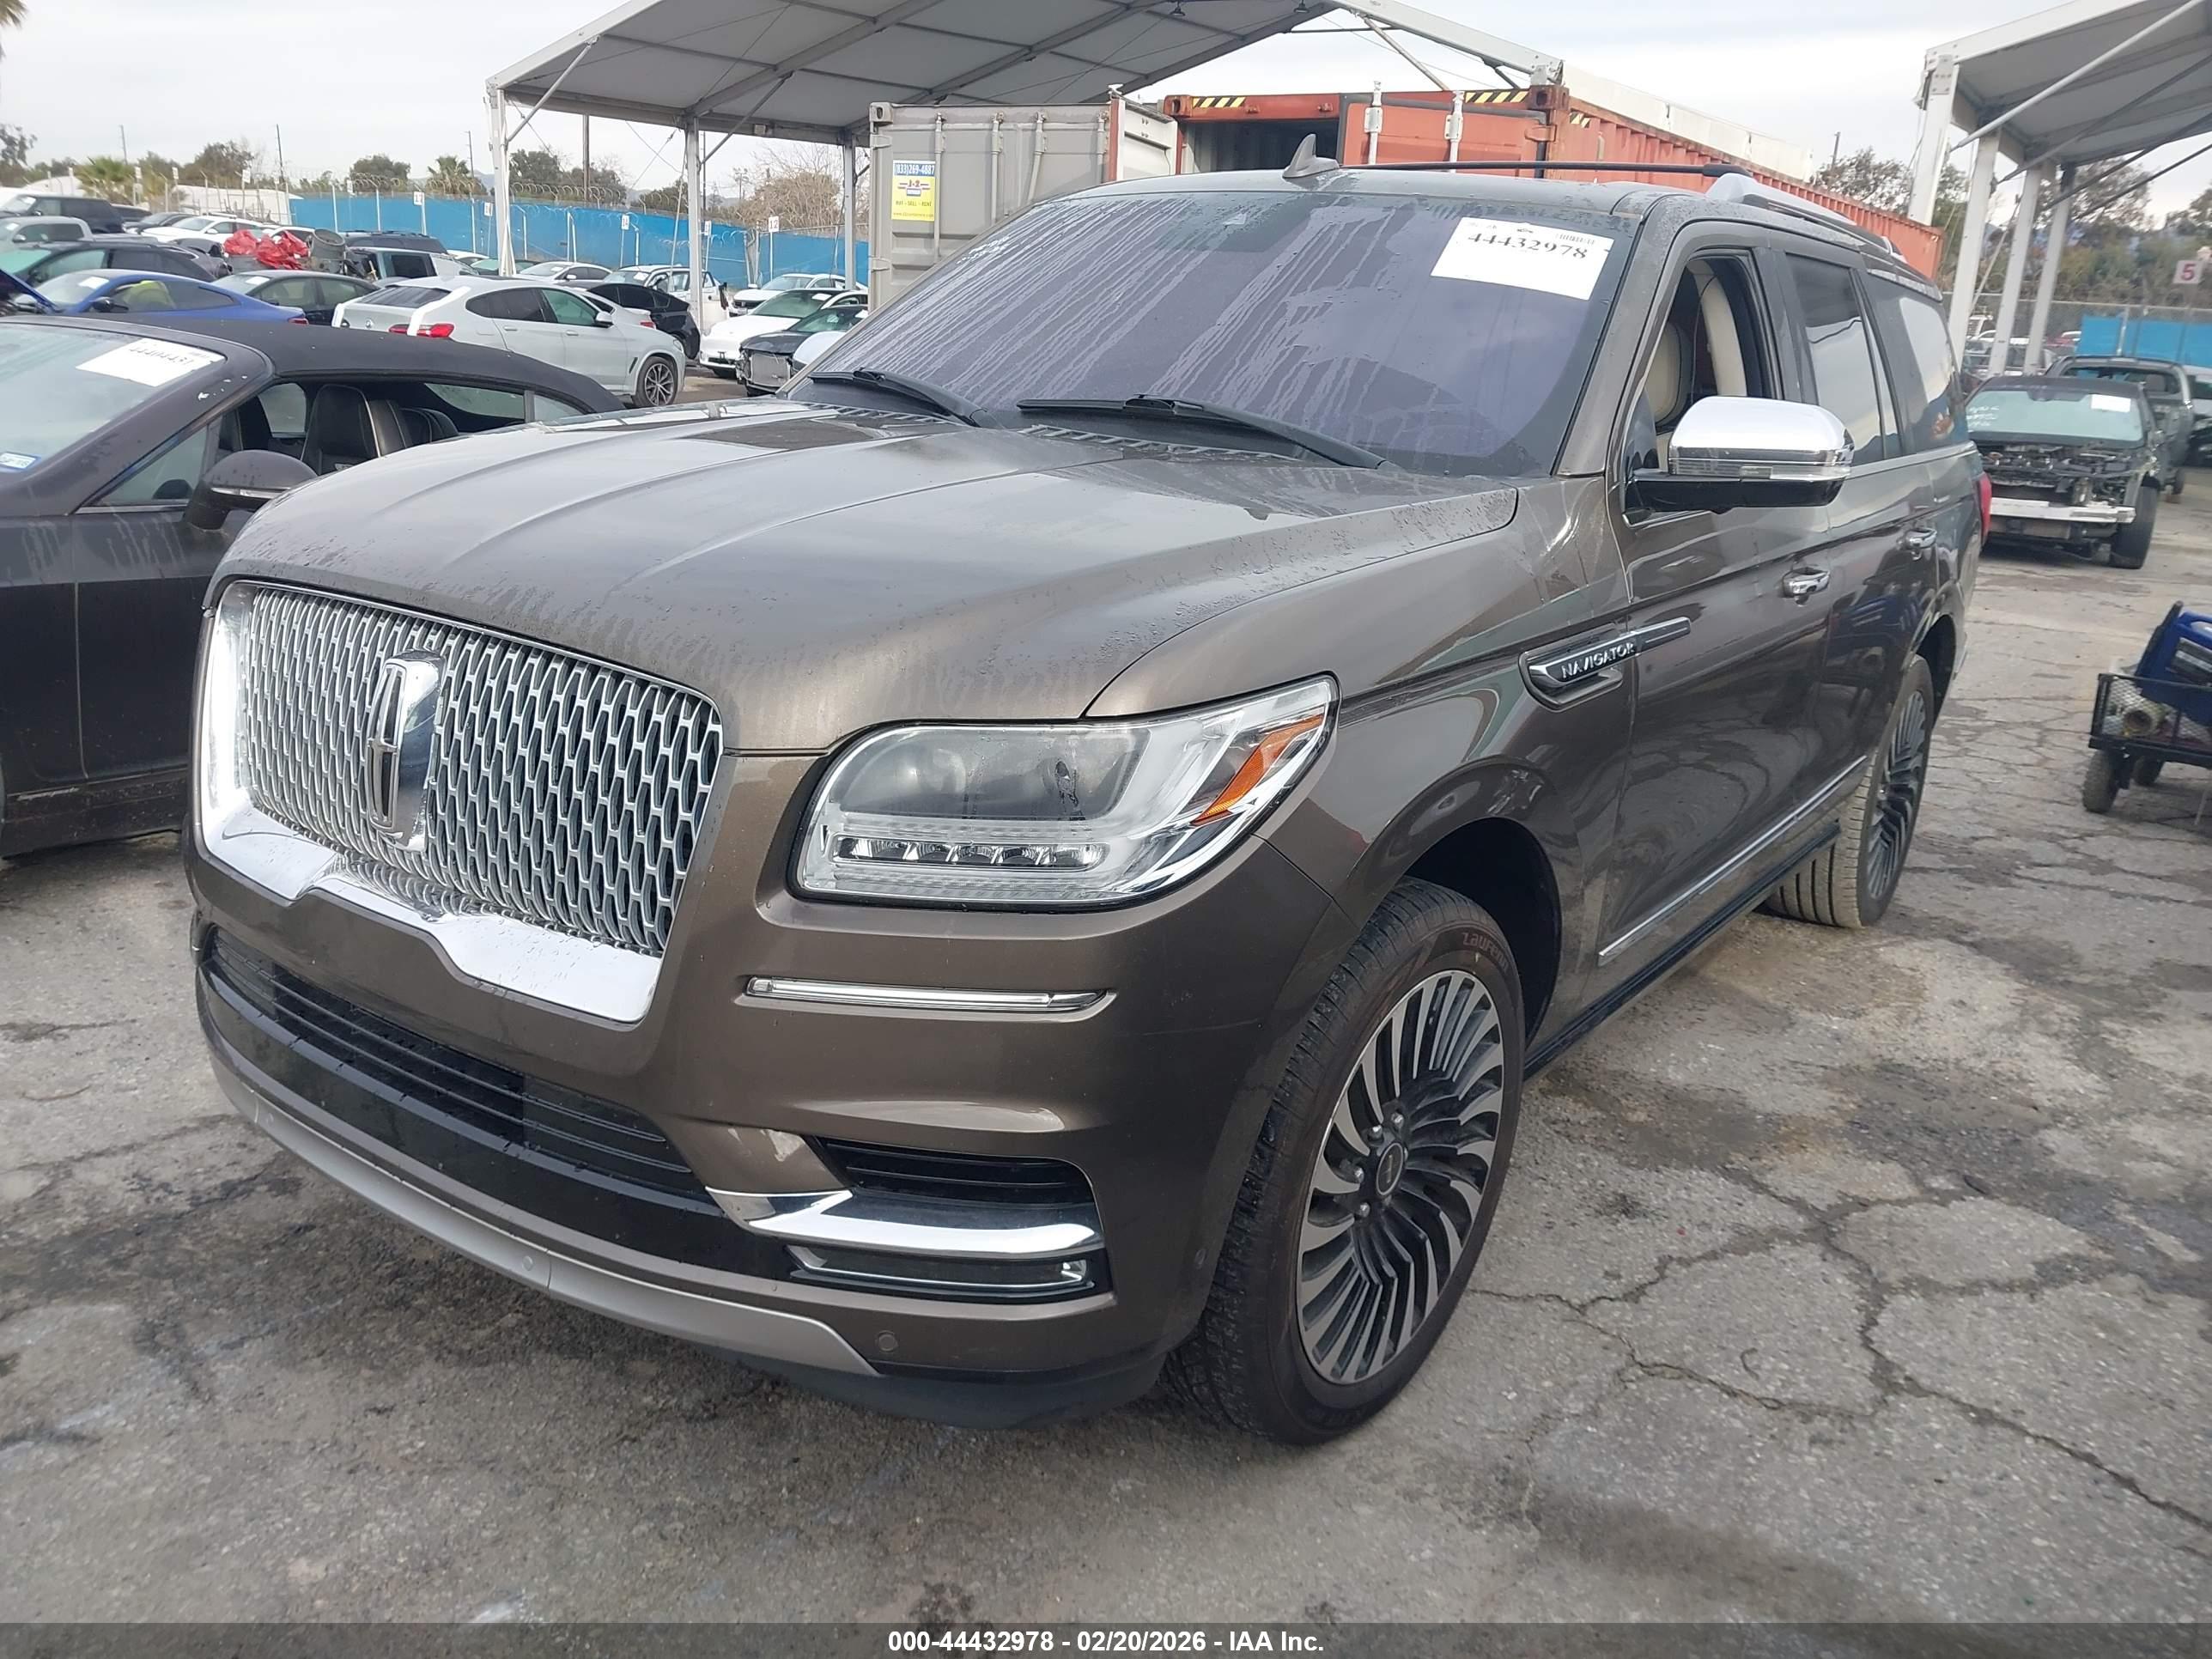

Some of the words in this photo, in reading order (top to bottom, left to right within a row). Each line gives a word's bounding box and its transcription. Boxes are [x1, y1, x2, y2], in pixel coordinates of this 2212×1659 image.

[769, 220, 778, 229] 12
[1468, 233, 1588, 258] 44432978
[2181, 263, 2196, 281] 5
[1561, 643, 1635, 679] NAVIGATOR
